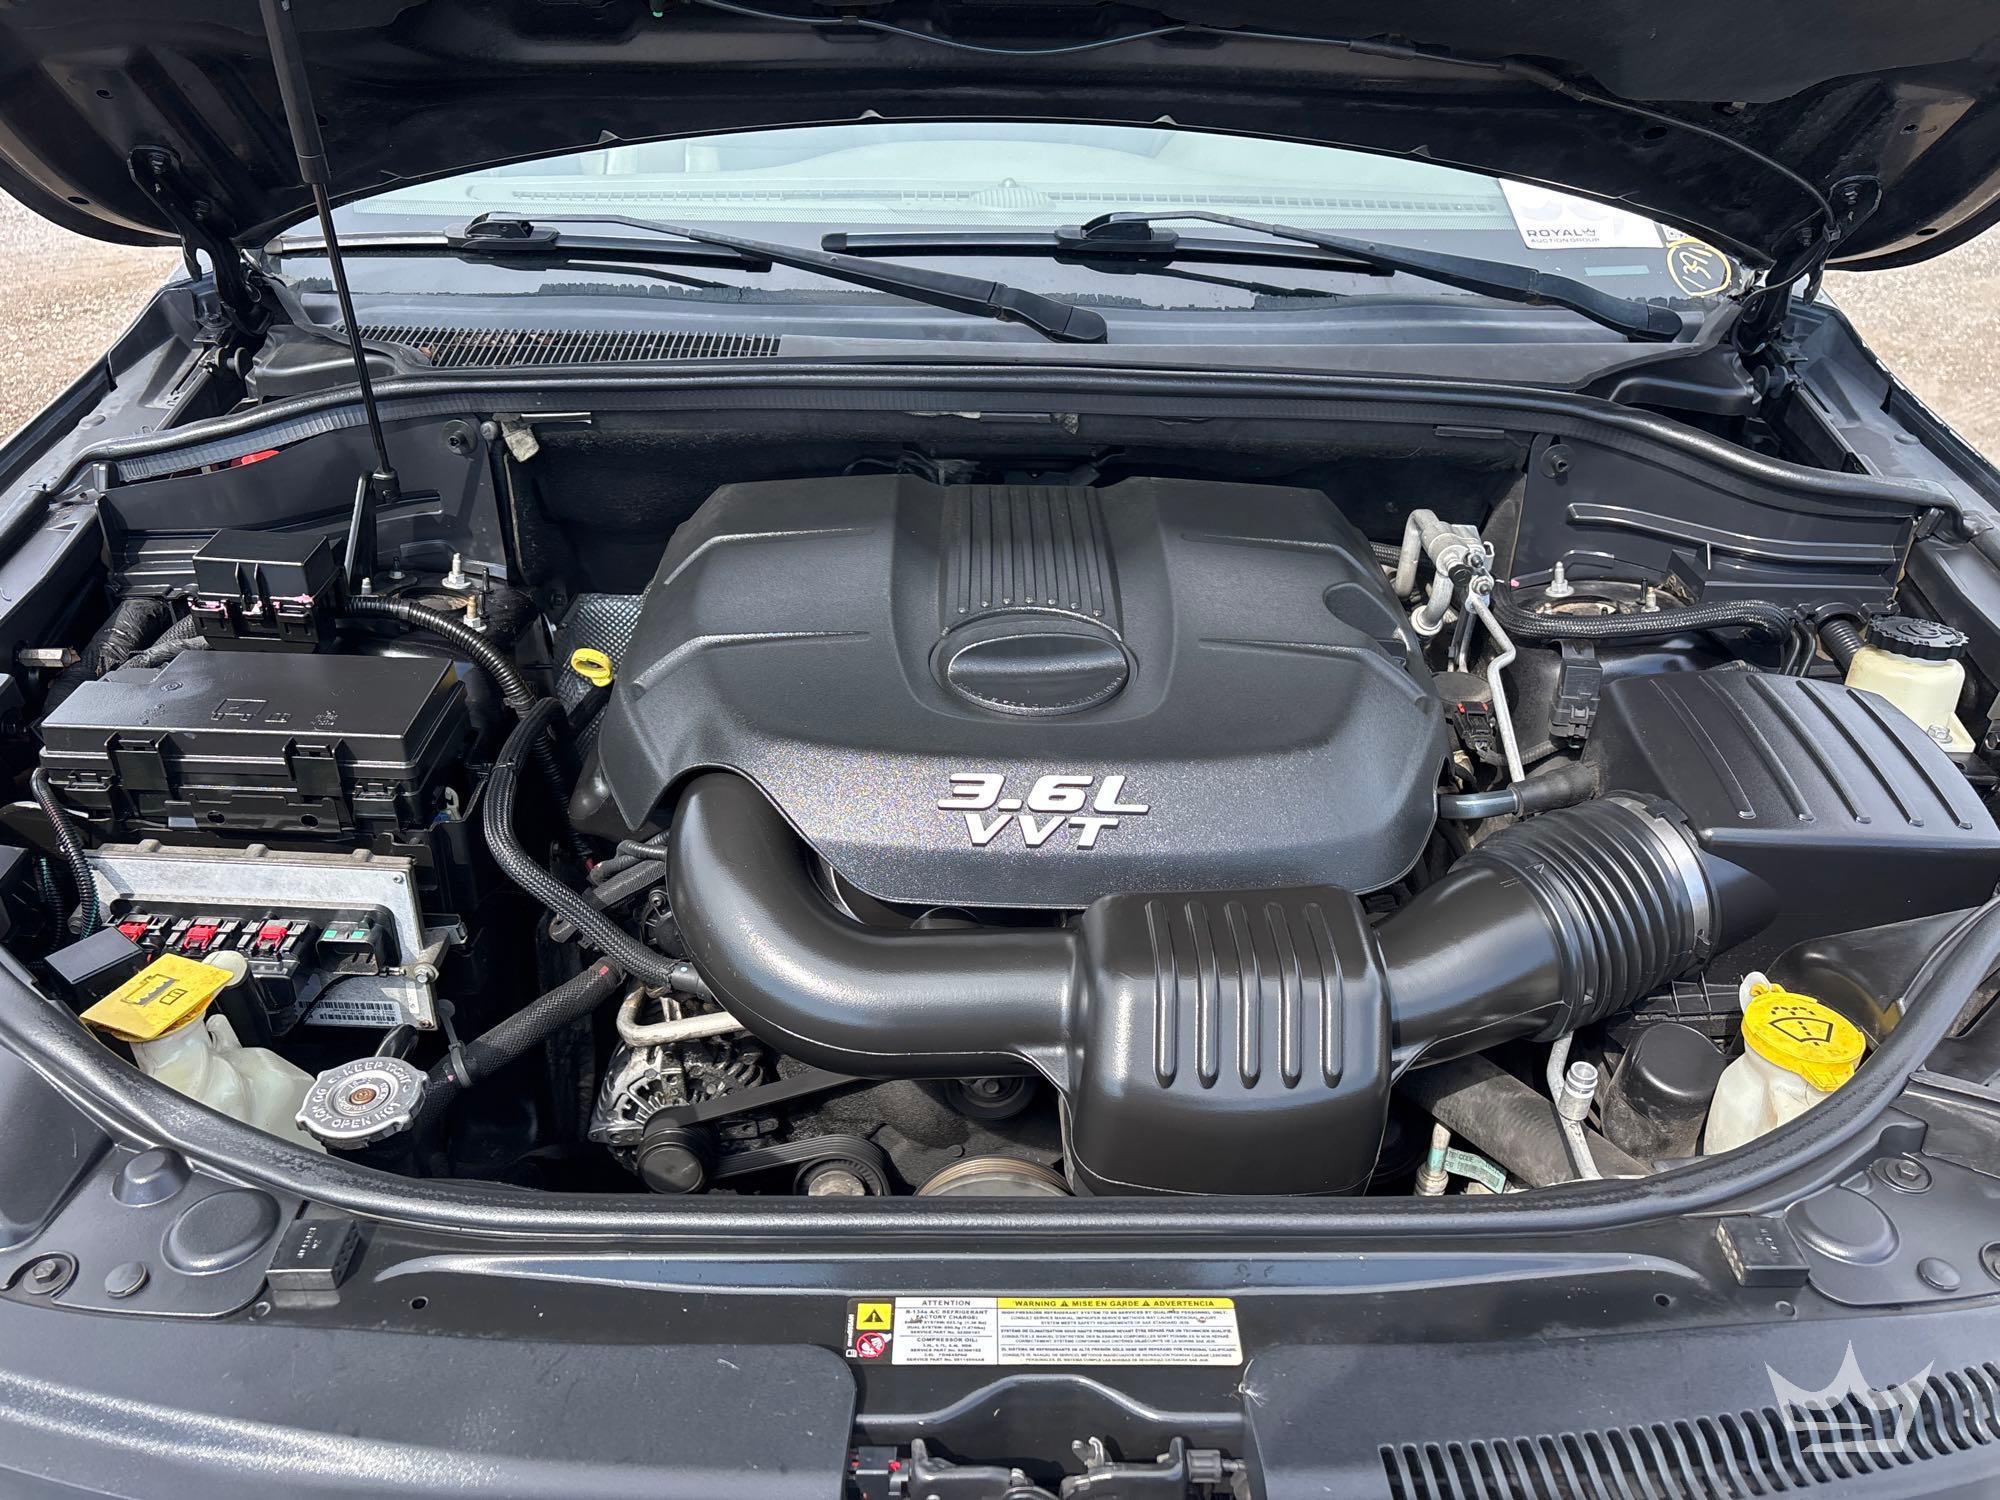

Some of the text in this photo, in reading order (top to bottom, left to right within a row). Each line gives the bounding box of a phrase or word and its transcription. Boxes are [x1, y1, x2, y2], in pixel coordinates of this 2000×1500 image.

[1527, 229, 1583, 237] ROYAL
[938, 772, 1150, 815] 3.6L
[963, 813, 1120, 851] VVT
[342, 1060, 382, 1076] KEEP
[331, 1118, 372, 1130] OPEN
[374, 1101, 401, 1121] HOT
